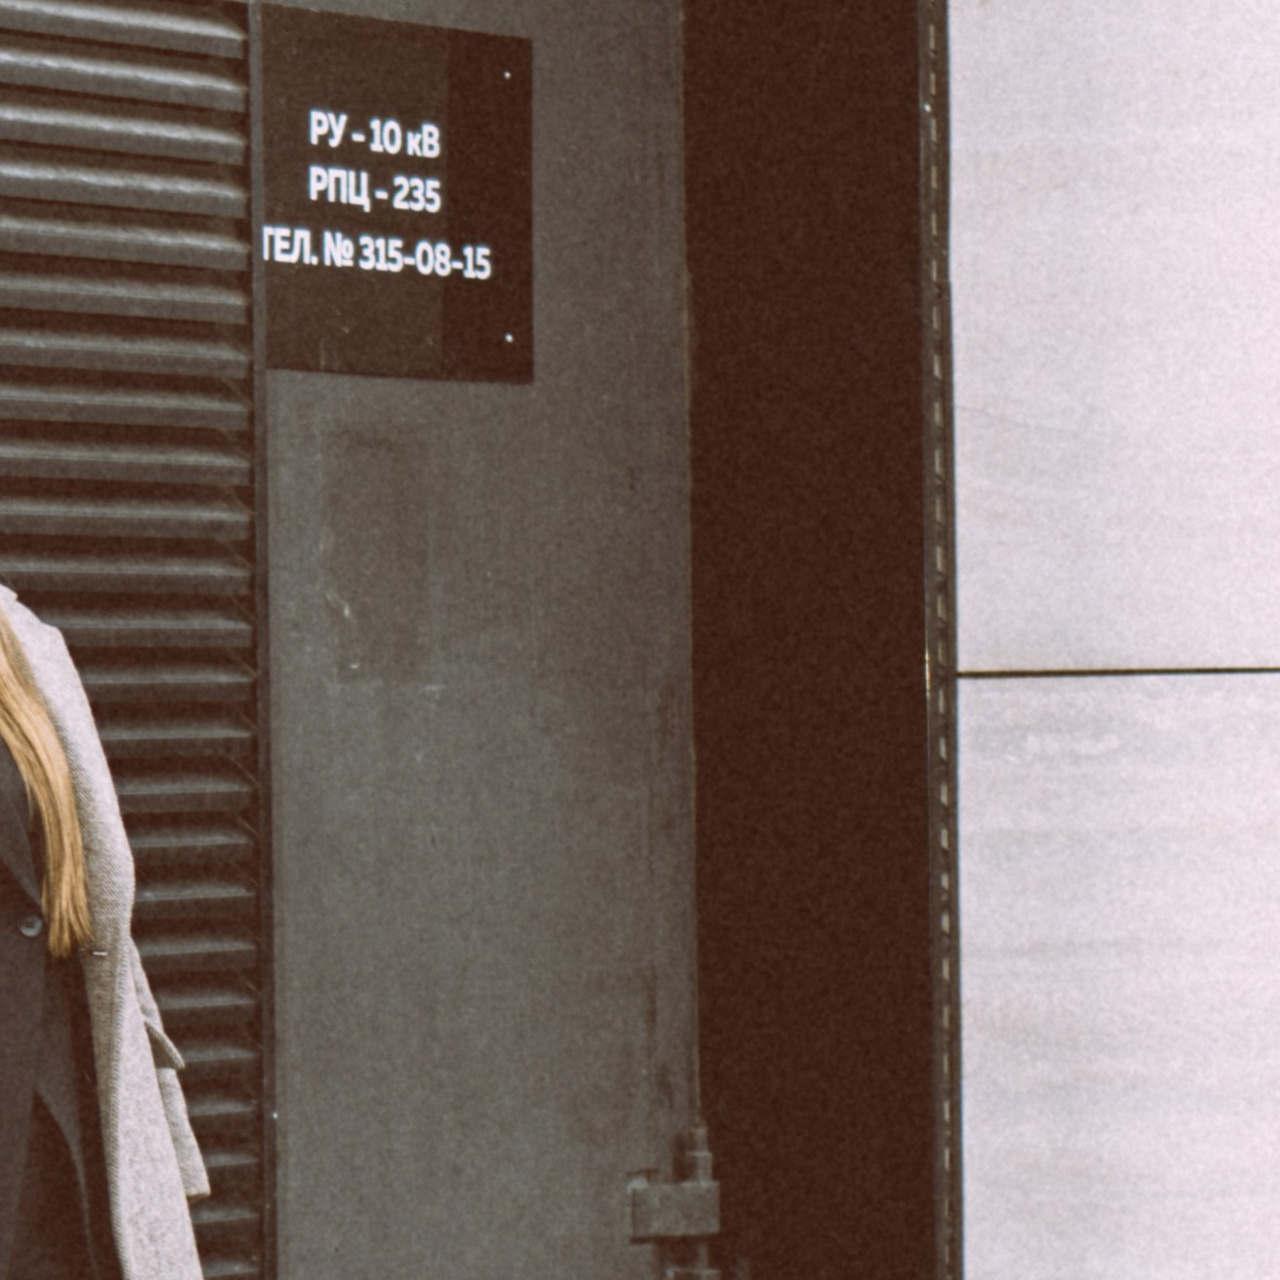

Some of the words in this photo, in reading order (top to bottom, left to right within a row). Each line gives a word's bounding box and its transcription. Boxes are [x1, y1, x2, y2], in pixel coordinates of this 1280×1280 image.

[406, 122, 441, 159] кВ
[322, 230, 355, 268] №
[358, 234, 492, 280] 315-08-15
